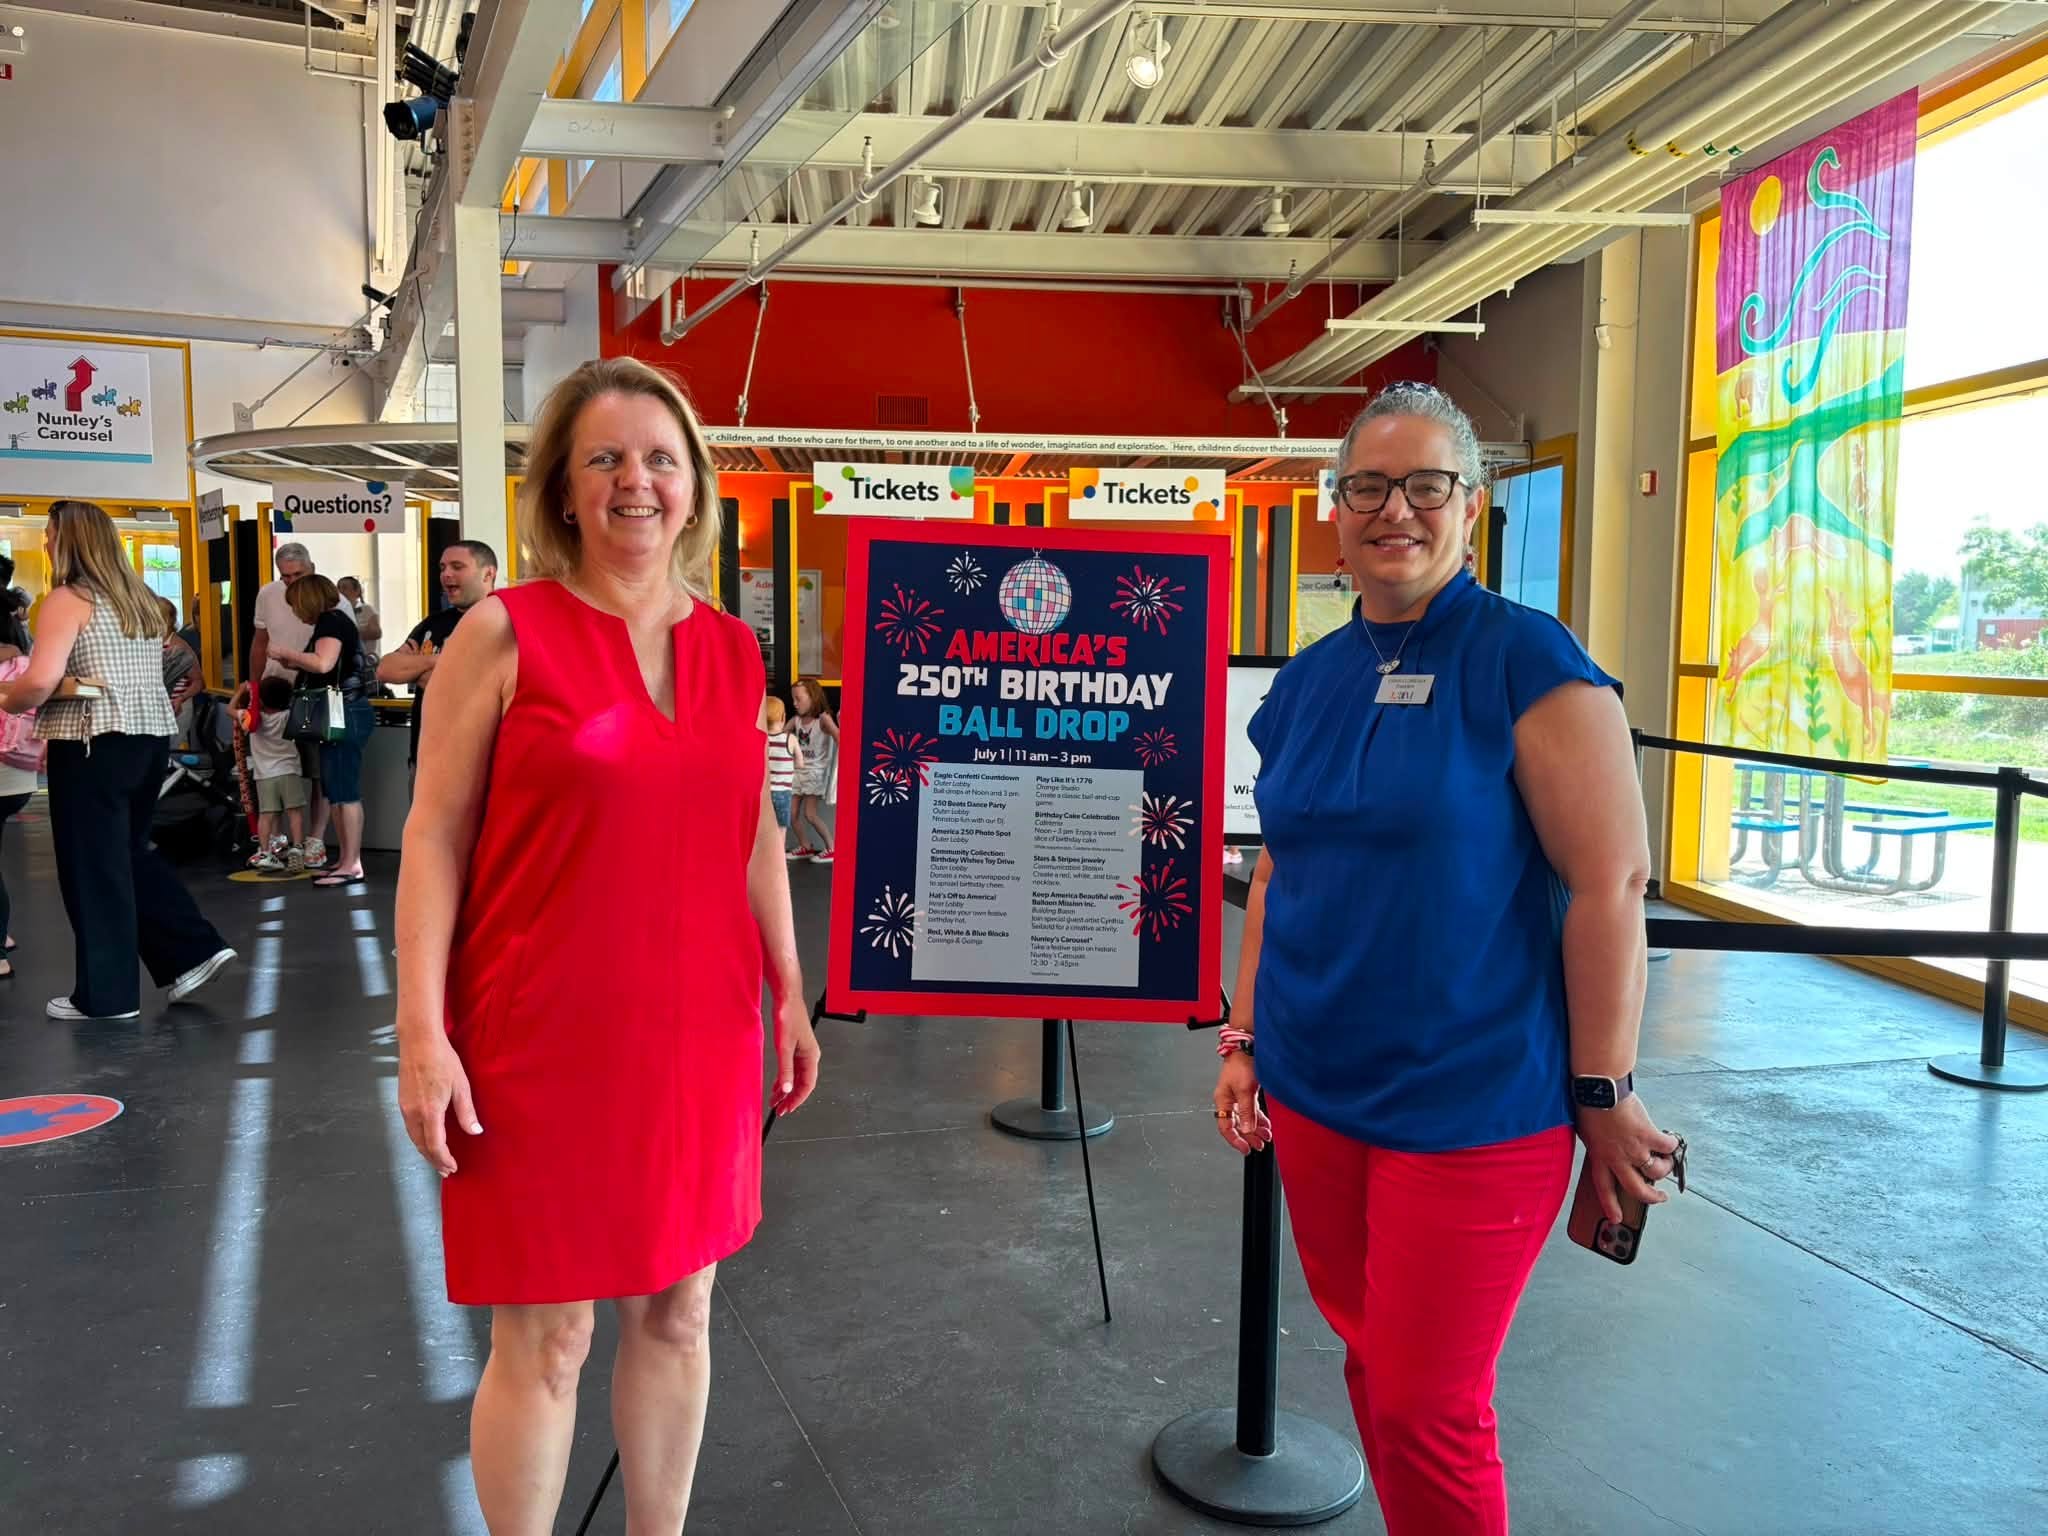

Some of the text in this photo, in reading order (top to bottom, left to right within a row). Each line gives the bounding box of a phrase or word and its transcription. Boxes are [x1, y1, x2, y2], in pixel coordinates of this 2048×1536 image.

[37, 412, 112, 429] Nunley's
[37, 427, 112, 441] Carousel
[716, 434, 755, 443] children,
[859, 437, 884, 445] them,
[986, 440, 998, 448] life
[1048, 441, 1098, 450] imagination
[1117, 443, 1167, 451] exploration.
[1173, 444, 1195, 452] Here,
[1270, 445, 1289, 453] their
[1291, 446, 1326, 454] passions
[849, 477, 939, 501] Tickets
[1104, 482, 1191, 505] Tickets
[285, 494, 392, 514] Questions?
[945, 629, 1128, 667] AMERICA'S
[1000, 669, 1173, 710] BIRTHDAY
[939, 704, 1129, 742] BALL DROP
[973, 748, 996, 762] July
[1000, 749, 1005, 759] 1
[1015, 750, 1027, 761] 11
[1030, 752, 1048, 761] am
[1061, 752, 1069, 762] 3
[1071, 753, 1091, 764] pm
[930, 856, 959, 864] Birthday
[931, 848, 969, 856] Community
